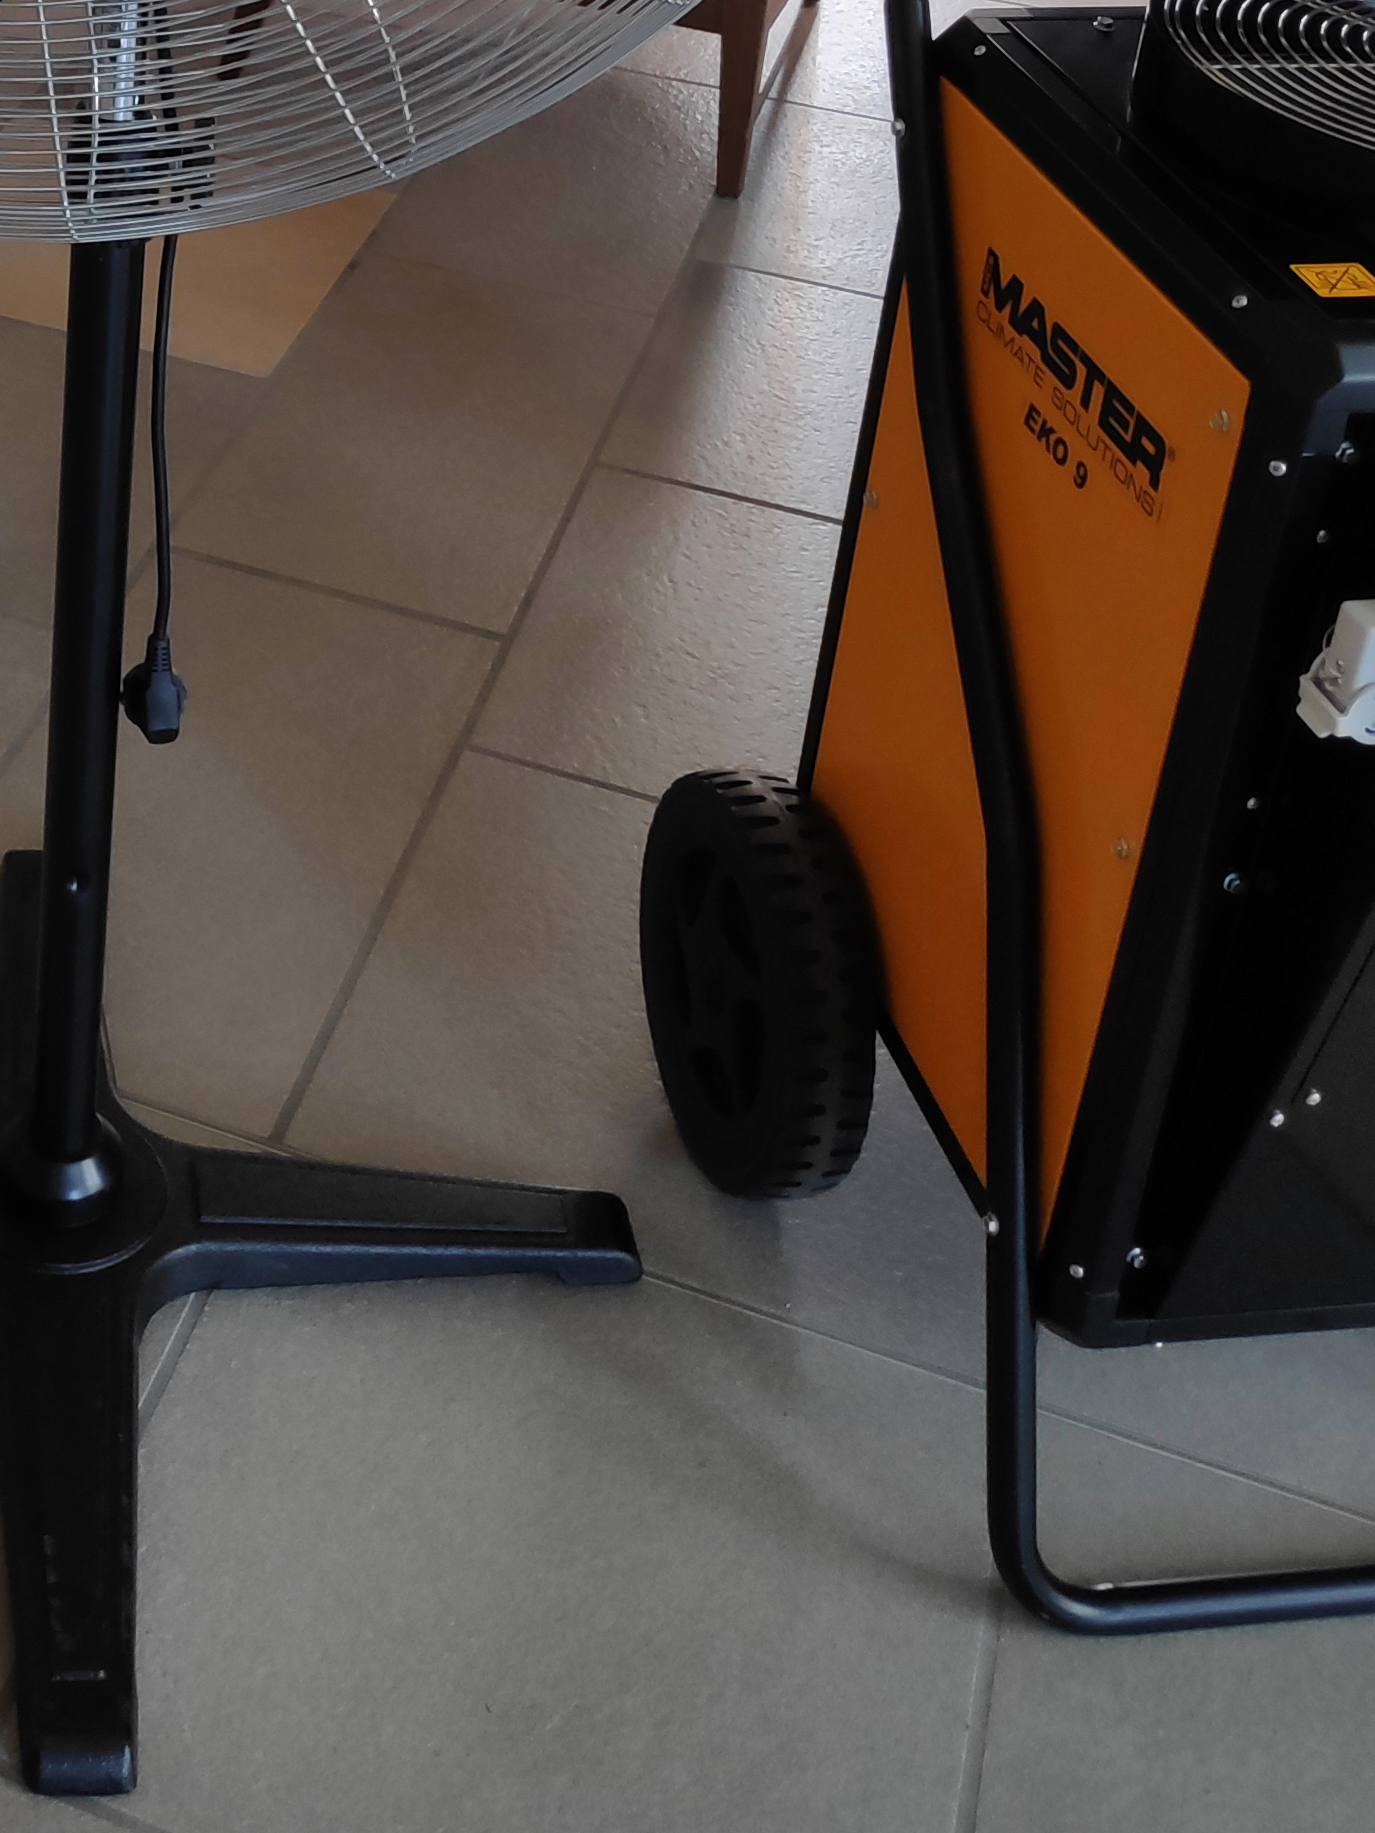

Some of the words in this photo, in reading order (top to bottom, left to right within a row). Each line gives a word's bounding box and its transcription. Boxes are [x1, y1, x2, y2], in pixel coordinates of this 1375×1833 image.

[976, 299, 1046, 390] CLIMATE
[1050, 385, 1156, 518] SOLUTIONS
[980, 246, 1167, 493] MASTER
[1023, 402, 1070, 467] EKO
[1072, 460, 1089, 490] 9
